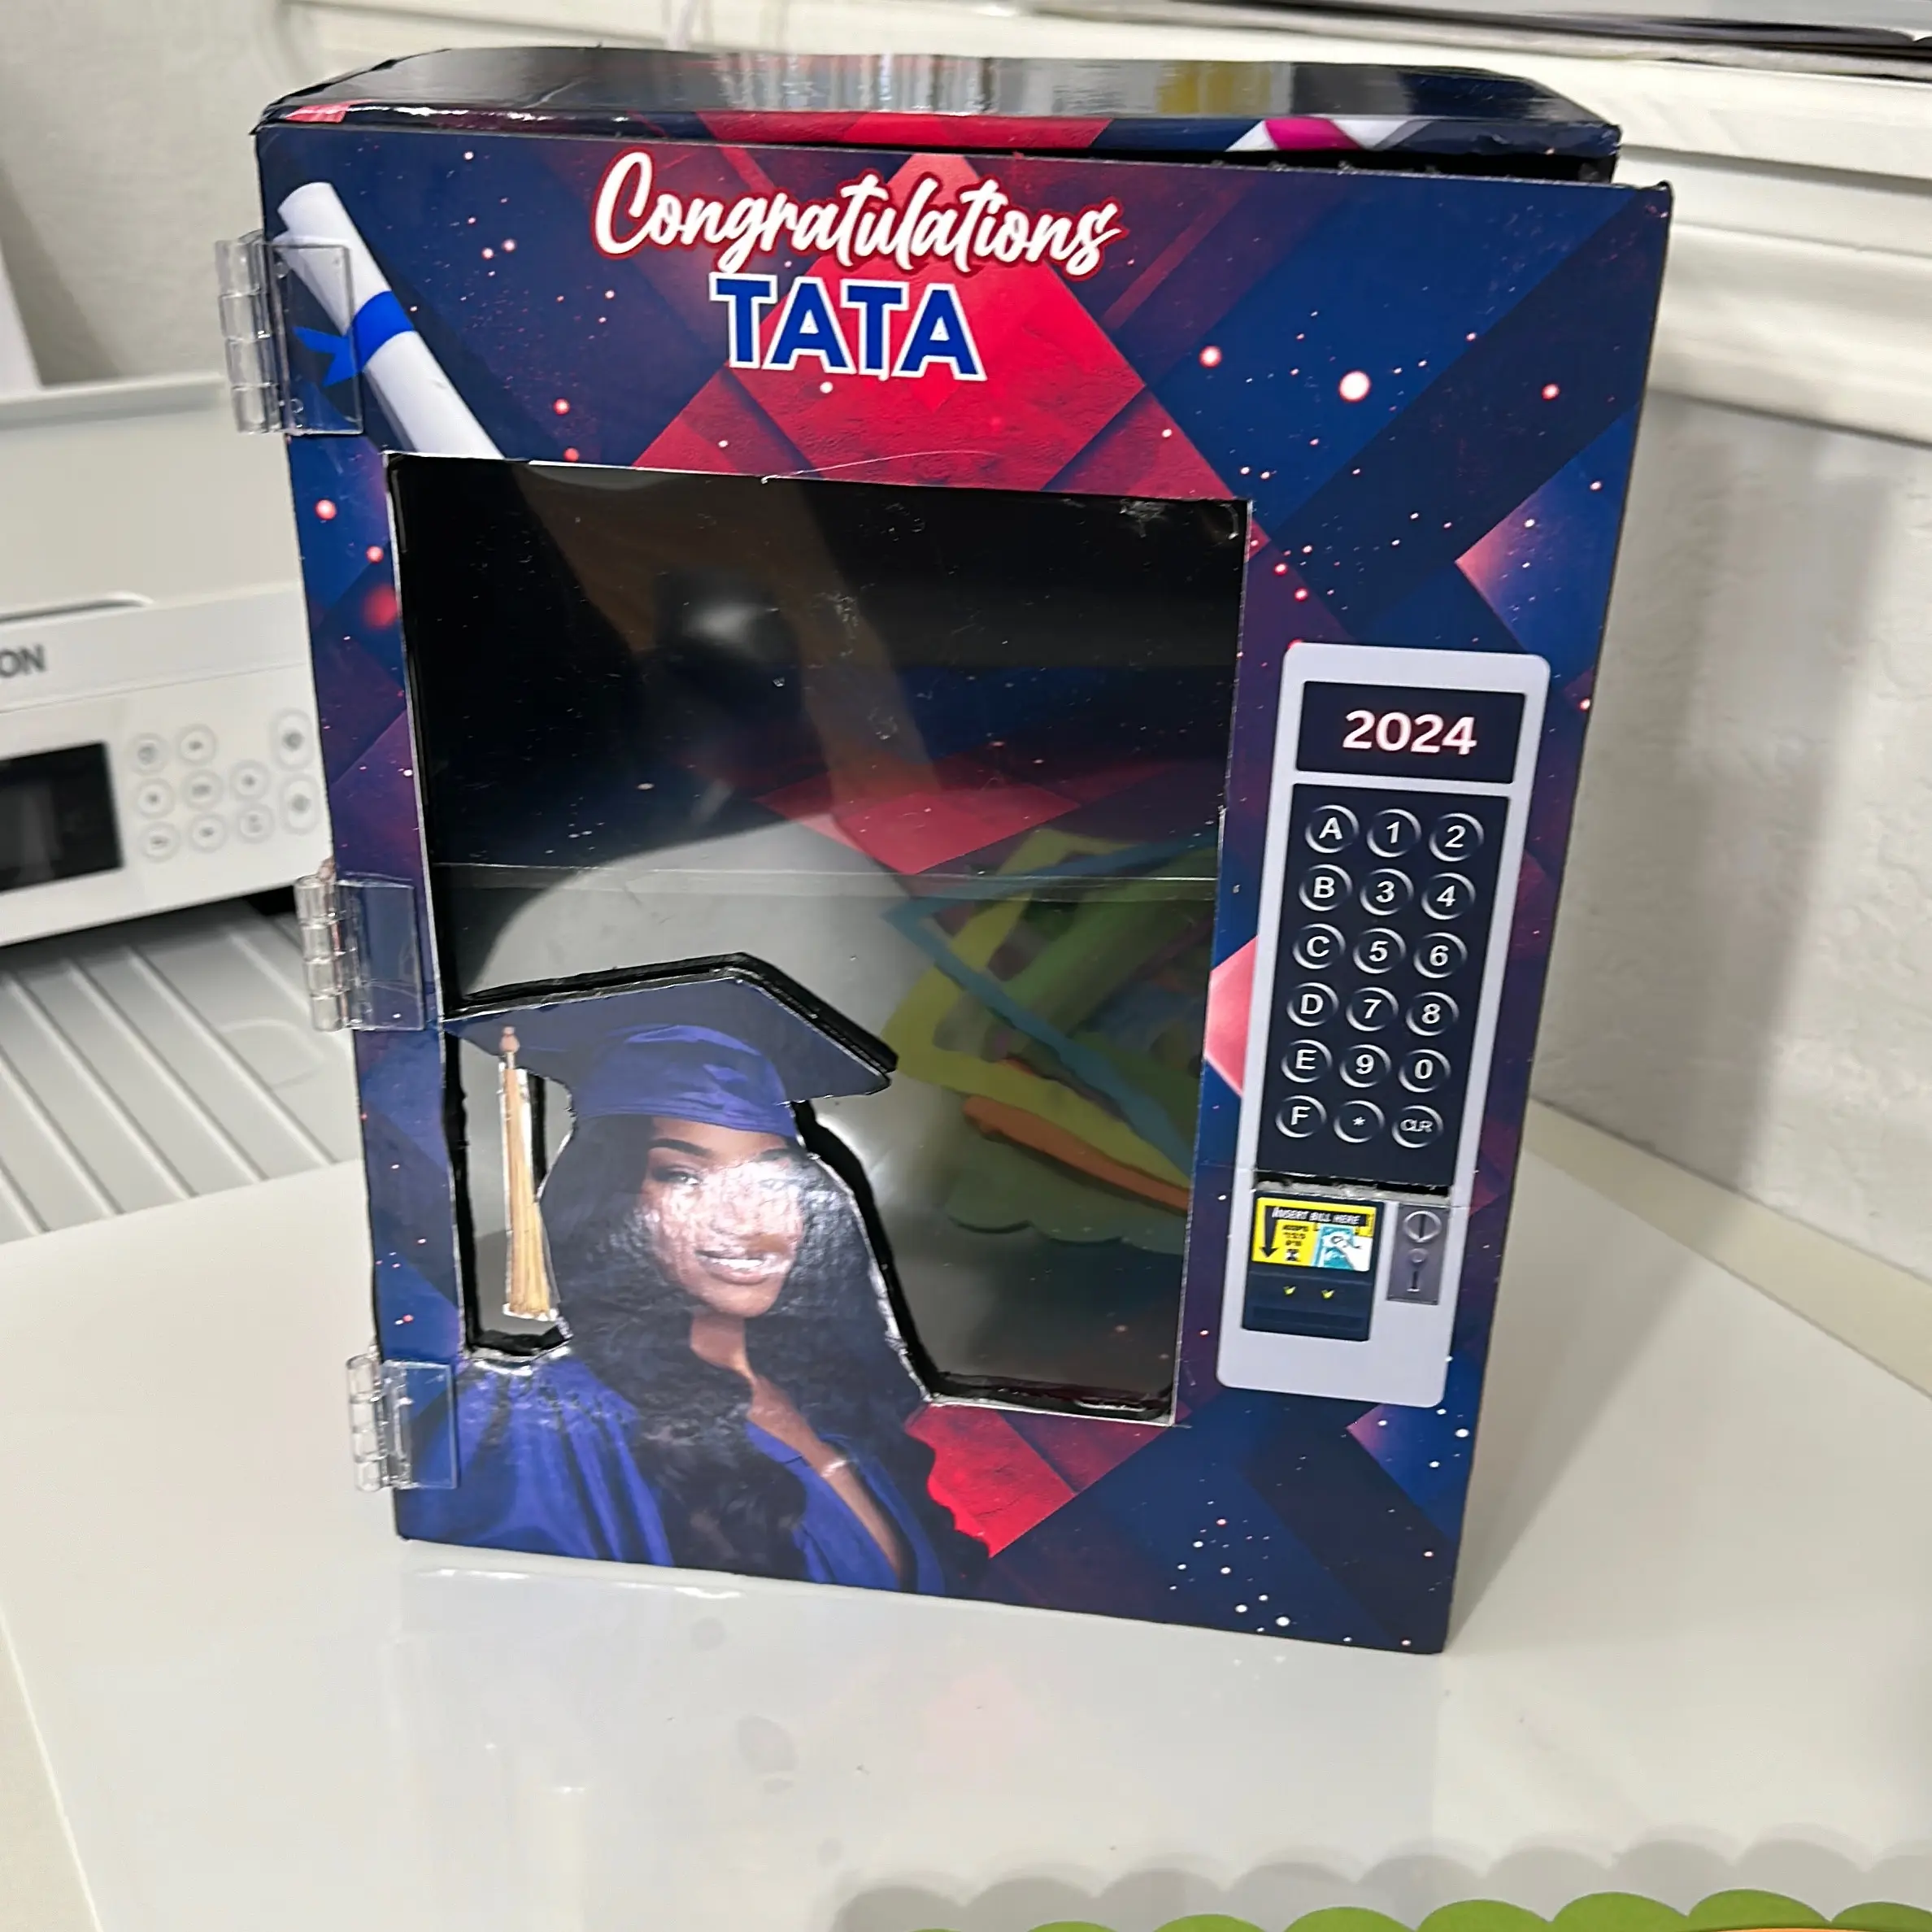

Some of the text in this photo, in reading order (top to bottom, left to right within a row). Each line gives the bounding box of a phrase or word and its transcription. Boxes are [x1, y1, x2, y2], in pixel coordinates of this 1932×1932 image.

[594, 149, 1123, 277] Congratulations
[709, 272, 987, 381] TATA
[1342, 709, 1477, 756] 2024
[1318, 816, 1466, 848] A 1 2
[1313, 876, 1456, 907] B 3 4
[1306, 935, 1449, 967] C 5 6
[1300, 993, 1442, 1025] D 7 8
[1295, 1049, 1434, 1080] E 9 0
[1290, 1106, 1434, 1133] F CLR
[1272, 1208, 1309, 1220] INSERT
[1308, 1212, 1331, 1222] BILL
[1332, 1214, 1361, 1225] HERE
